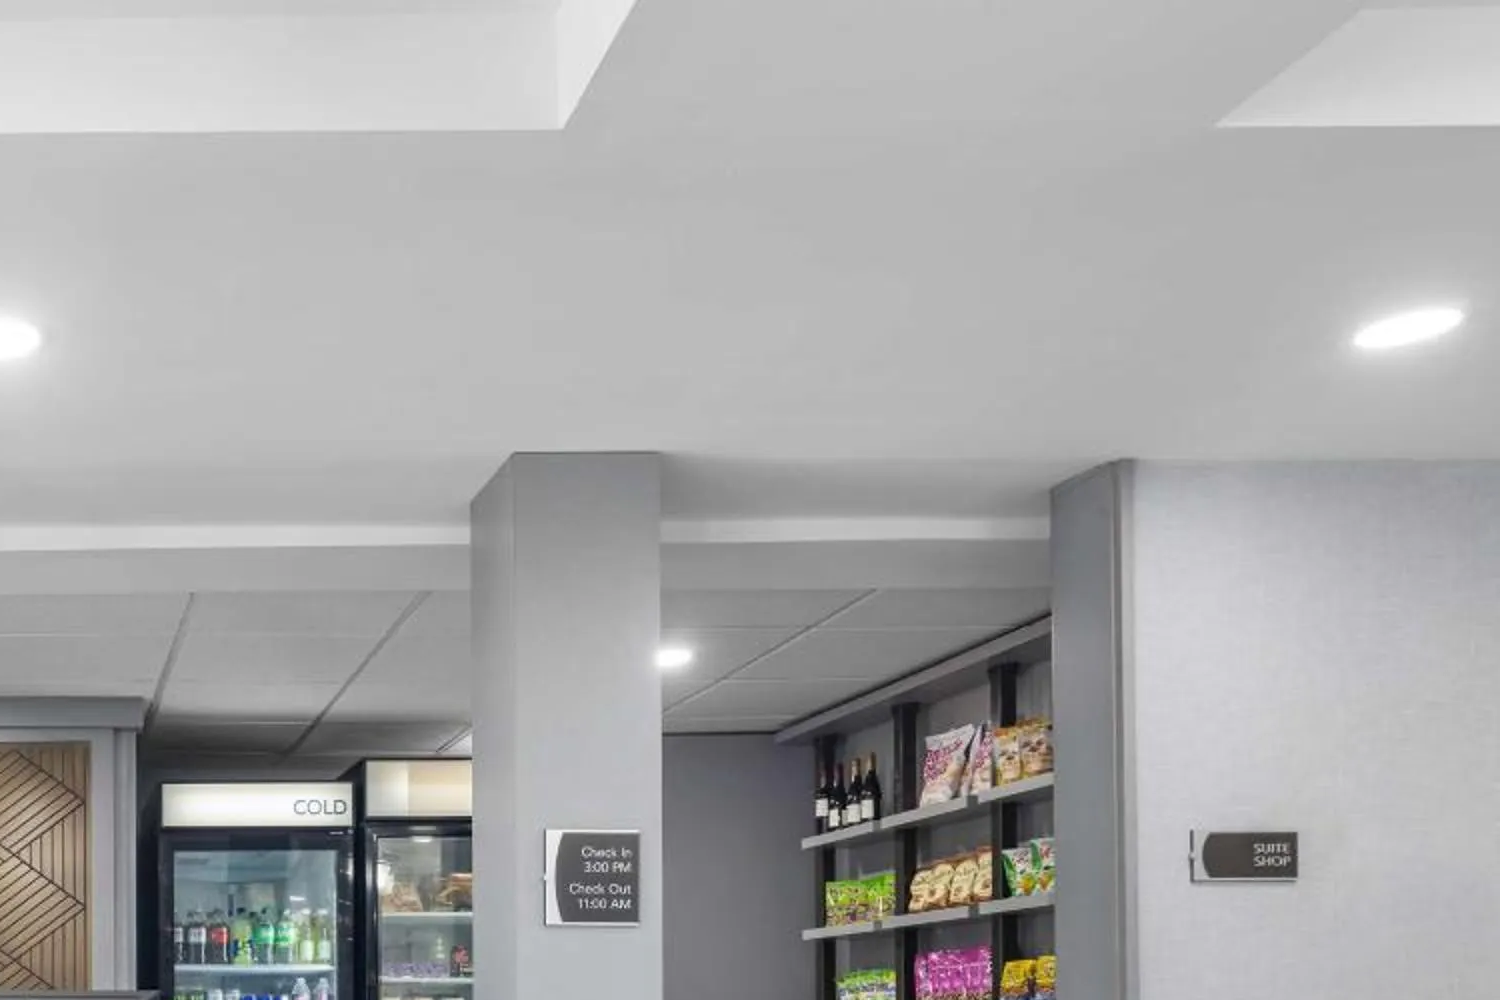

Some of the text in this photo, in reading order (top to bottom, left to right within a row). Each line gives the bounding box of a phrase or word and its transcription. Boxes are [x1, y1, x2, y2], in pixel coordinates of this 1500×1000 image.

[293, 799, 347, 815] COLD
[581, 846, 633, 858] Check In
[1253, 843, 1291, 854] SUITE
[584, 861, 632, 873] 3:00 PM
[1253, 855, 1292, 867] SHOP
[569, 883, 631, 895] Check Out
[578, 898, 631, 909] 11:00 AM
